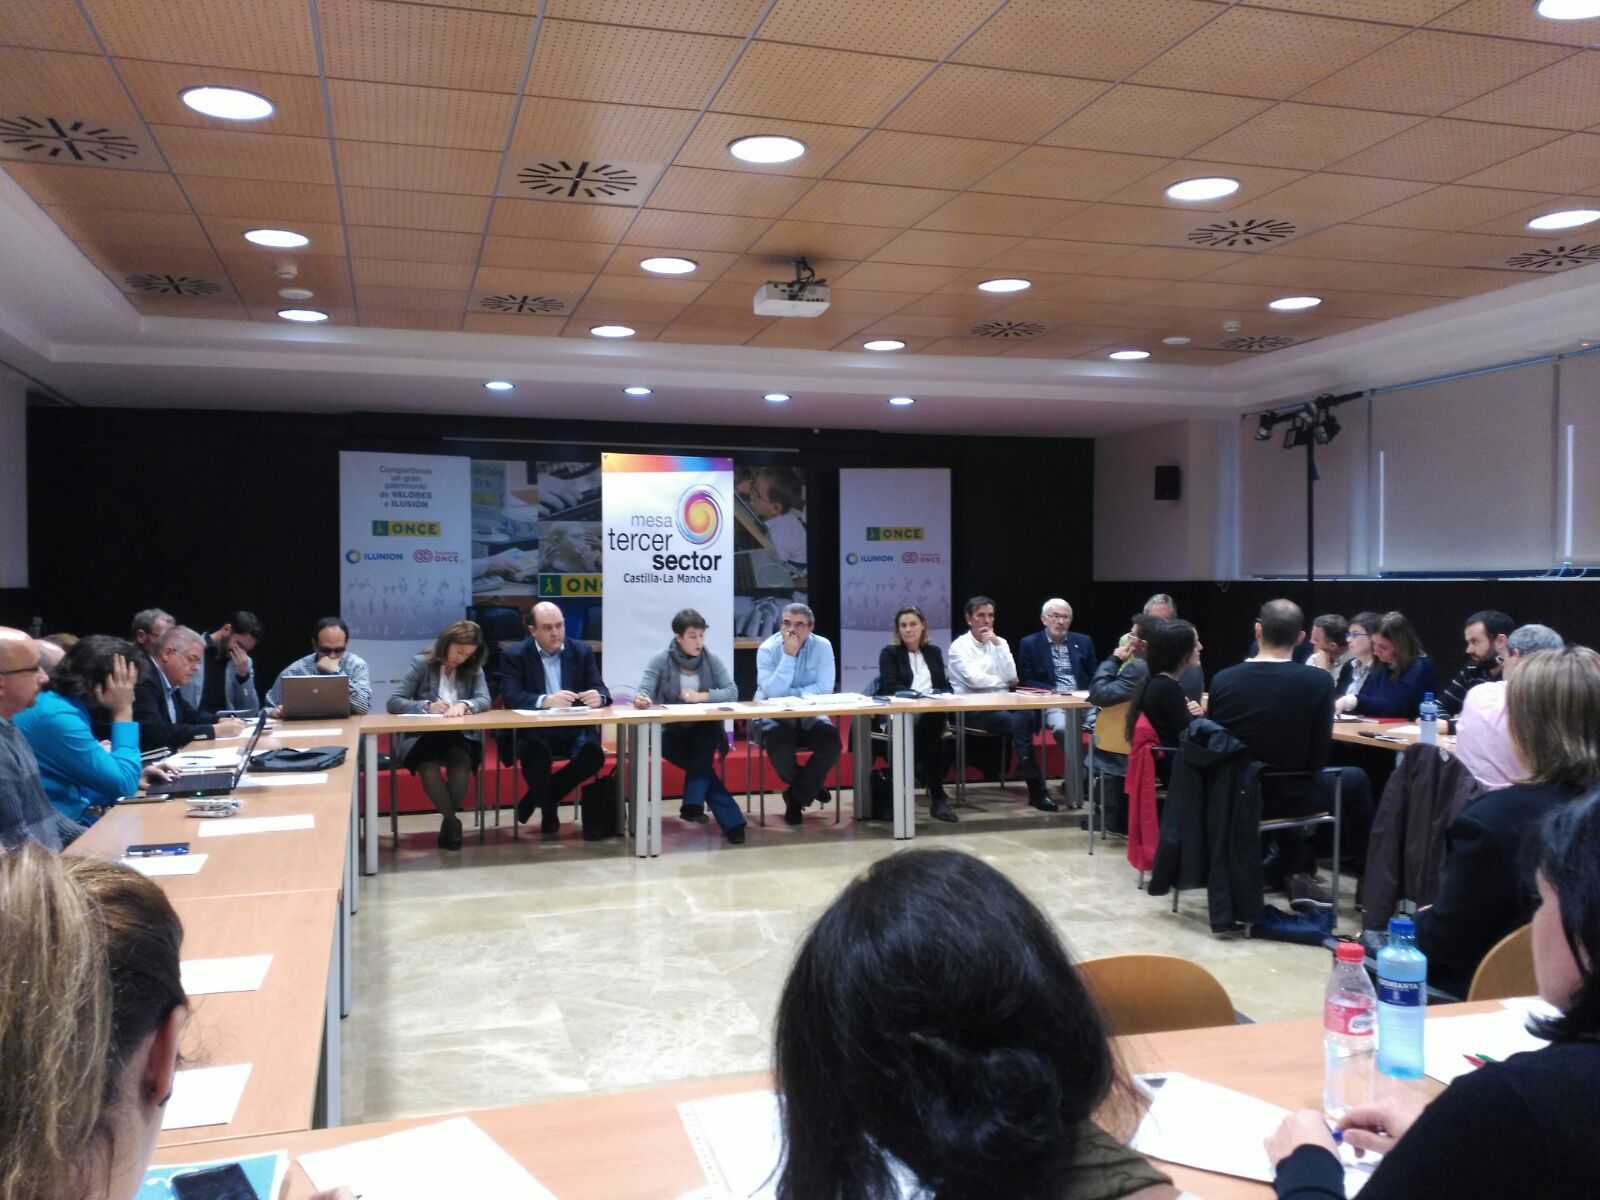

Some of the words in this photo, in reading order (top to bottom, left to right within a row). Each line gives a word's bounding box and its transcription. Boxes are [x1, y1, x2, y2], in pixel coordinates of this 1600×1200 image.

[391, 491, 433, 499] VALORES
[631, 514, 673, 528] mesa
[392, 523, 438, 534] ONCE
[883, 529, 922, 538] ONCE
[608, 527, 673, 552] tercer
[363, 552, 404, 561] ILUNION
[652, 551, 722, 571] sector
[623, 573, 674, 583] Castilla-La
[677, 573, 712, 583] Mancha
[566, 578, 602, 593] ON
